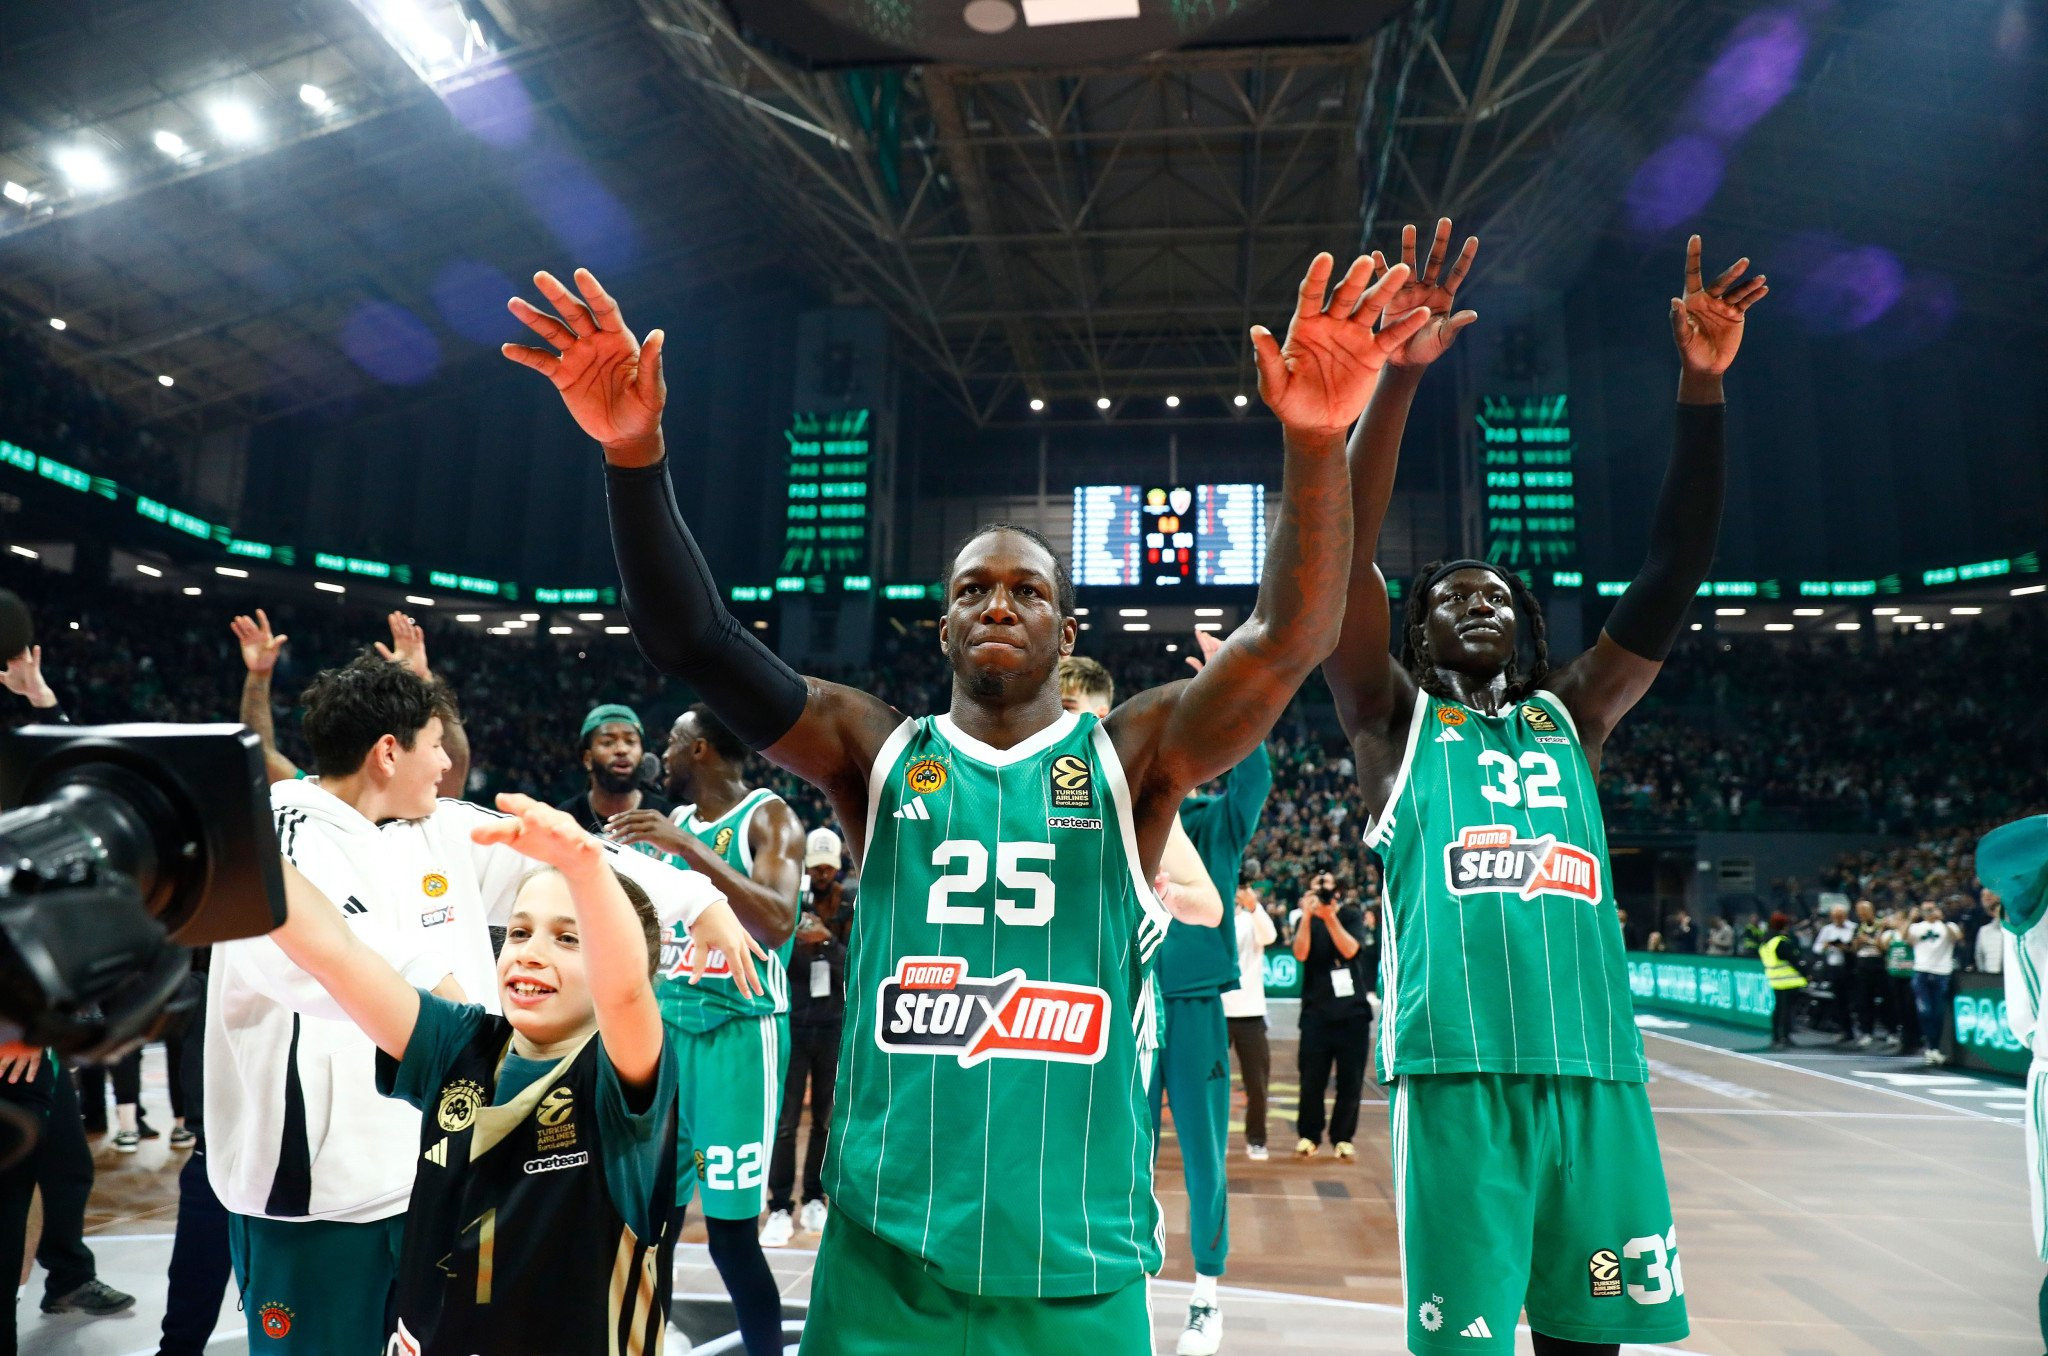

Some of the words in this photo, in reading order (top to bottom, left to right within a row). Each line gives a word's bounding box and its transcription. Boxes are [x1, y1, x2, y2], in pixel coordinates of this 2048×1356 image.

[1478, 750, 1568, 808] 32
[1048, 816, 1102, 829] oneteam
[1467, 831, 1507, 846] pame
[926, 840, 1056, 926] 25
[904, 966, 955, 986] pame
[537, 1122, 575, 1137] TURKISH
[537, 1130, 577, 1145] AIRLINES
[526, 1152, 588, 1172] oneteam
[706, 1142, 762, 1190] 22
